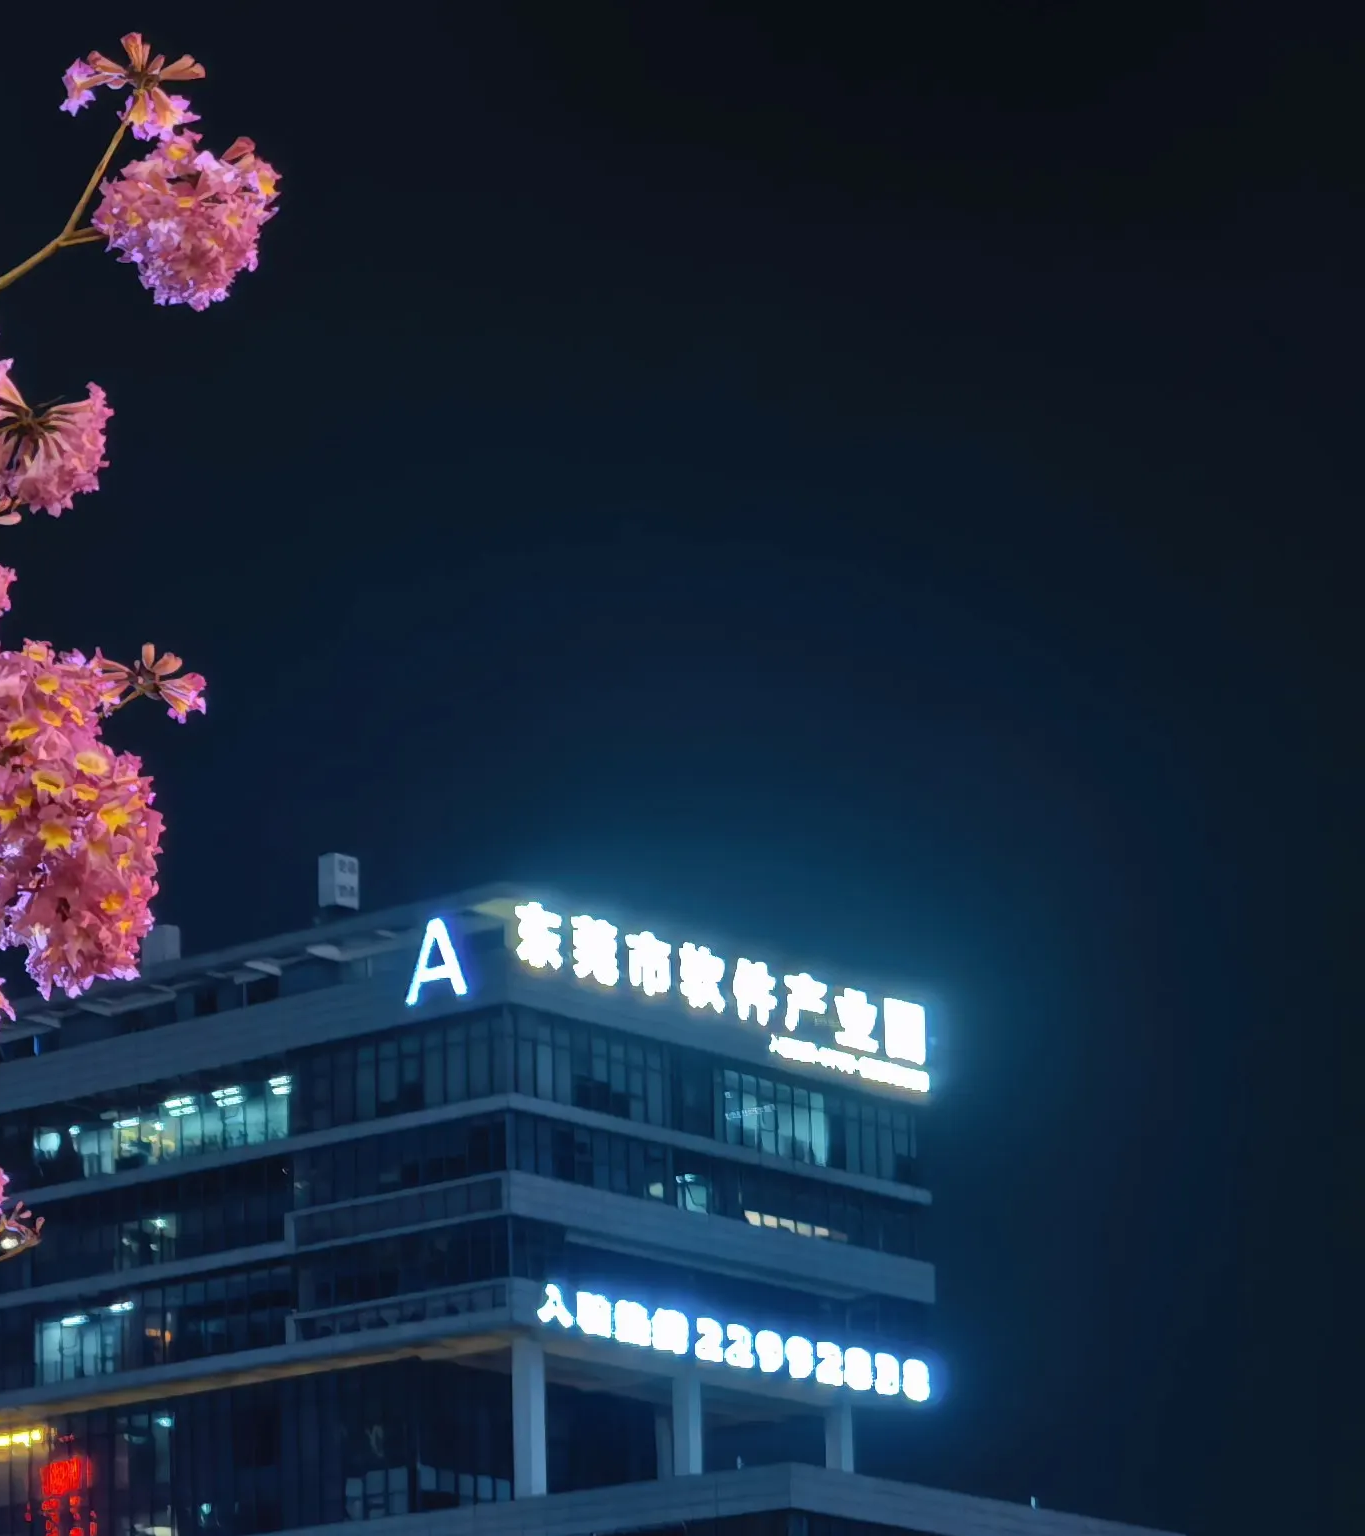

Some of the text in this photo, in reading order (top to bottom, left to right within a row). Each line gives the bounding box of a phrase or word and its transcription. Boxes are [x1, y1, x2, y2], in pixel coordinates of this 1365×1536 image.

[405, 917, 468, 1006] A
[514, 901, 926, 1065] 东莞市软件产业
